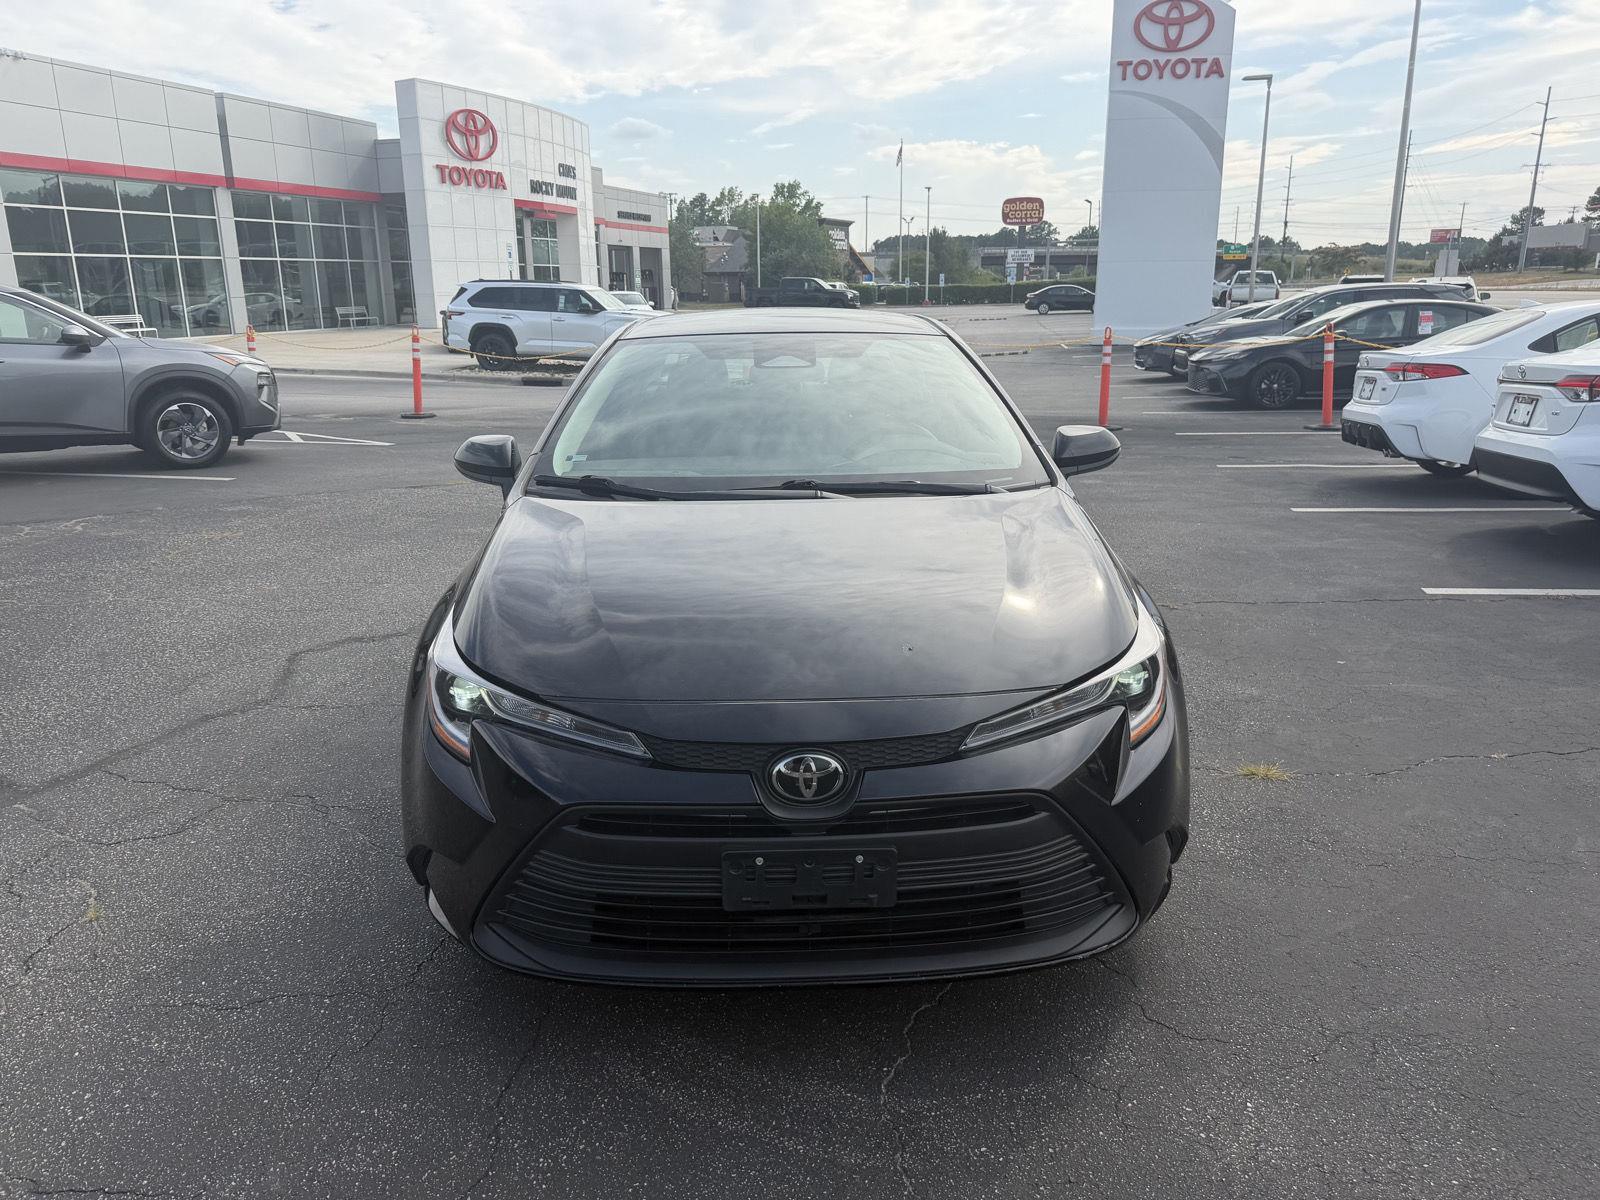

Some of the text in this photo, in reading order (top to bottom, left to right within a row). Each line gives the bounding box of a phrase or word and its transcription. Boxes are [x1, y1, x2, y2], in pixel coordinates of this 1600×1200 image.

[1117, 57, 1224, 81] TOYOTA
[436, 164, 507, 190] TOYOTA
[529, 179, 577, 200] ROCKY MOUNT
[1003, 201, 1040, 213] golden
[1008, 208, 1043, 219] corral
